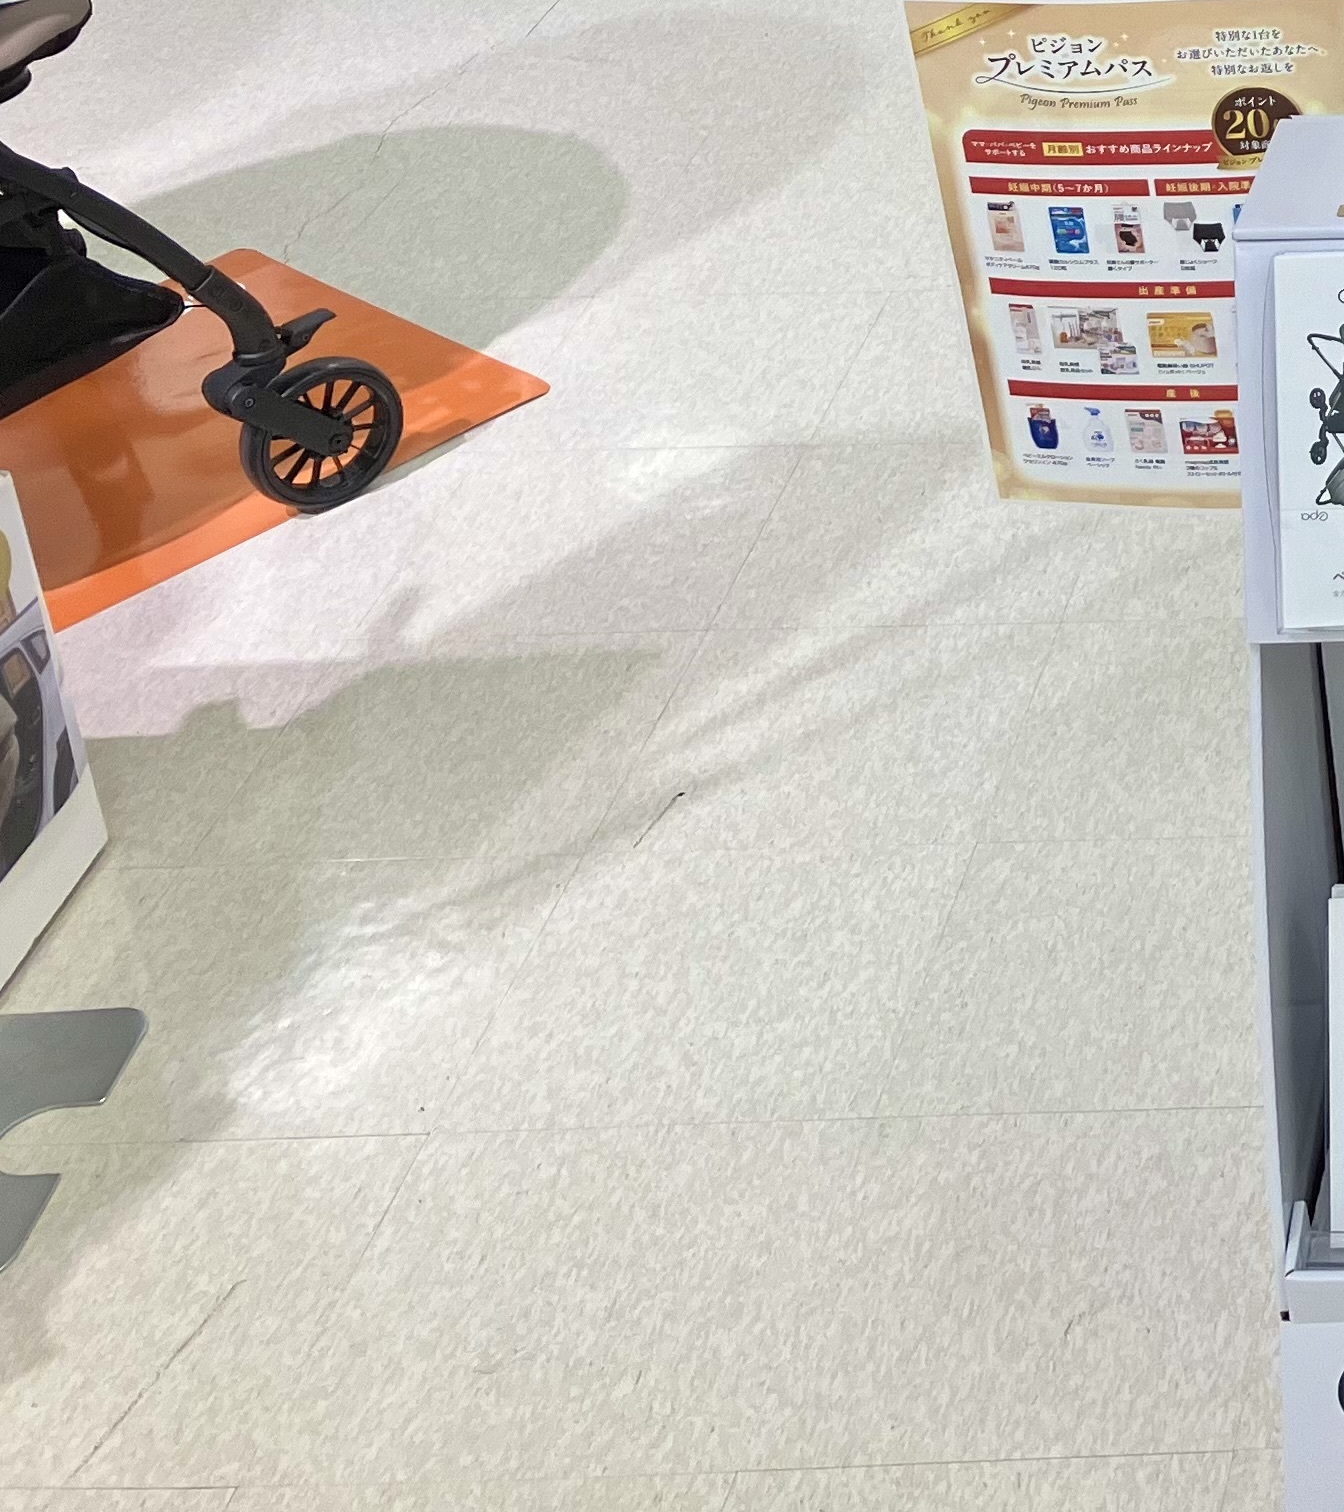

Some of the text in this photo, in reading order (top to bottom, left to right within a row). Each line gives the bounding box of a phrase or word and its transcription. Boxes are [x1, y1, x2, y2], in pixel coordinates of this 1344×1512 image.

[1215, 29, 1280, 41] 特別な1台を
[1031, 36, 1103, 54] ピジョン
[987, 54, 1152, 79] プレミアムパス
[1211, 62, 1293, 75] 特別なお返しを
[1020, 93, 1138, 110] Pigeon Premium Pass
[1085, 142, 1212, 154] おすすめ商品ラインナップ
